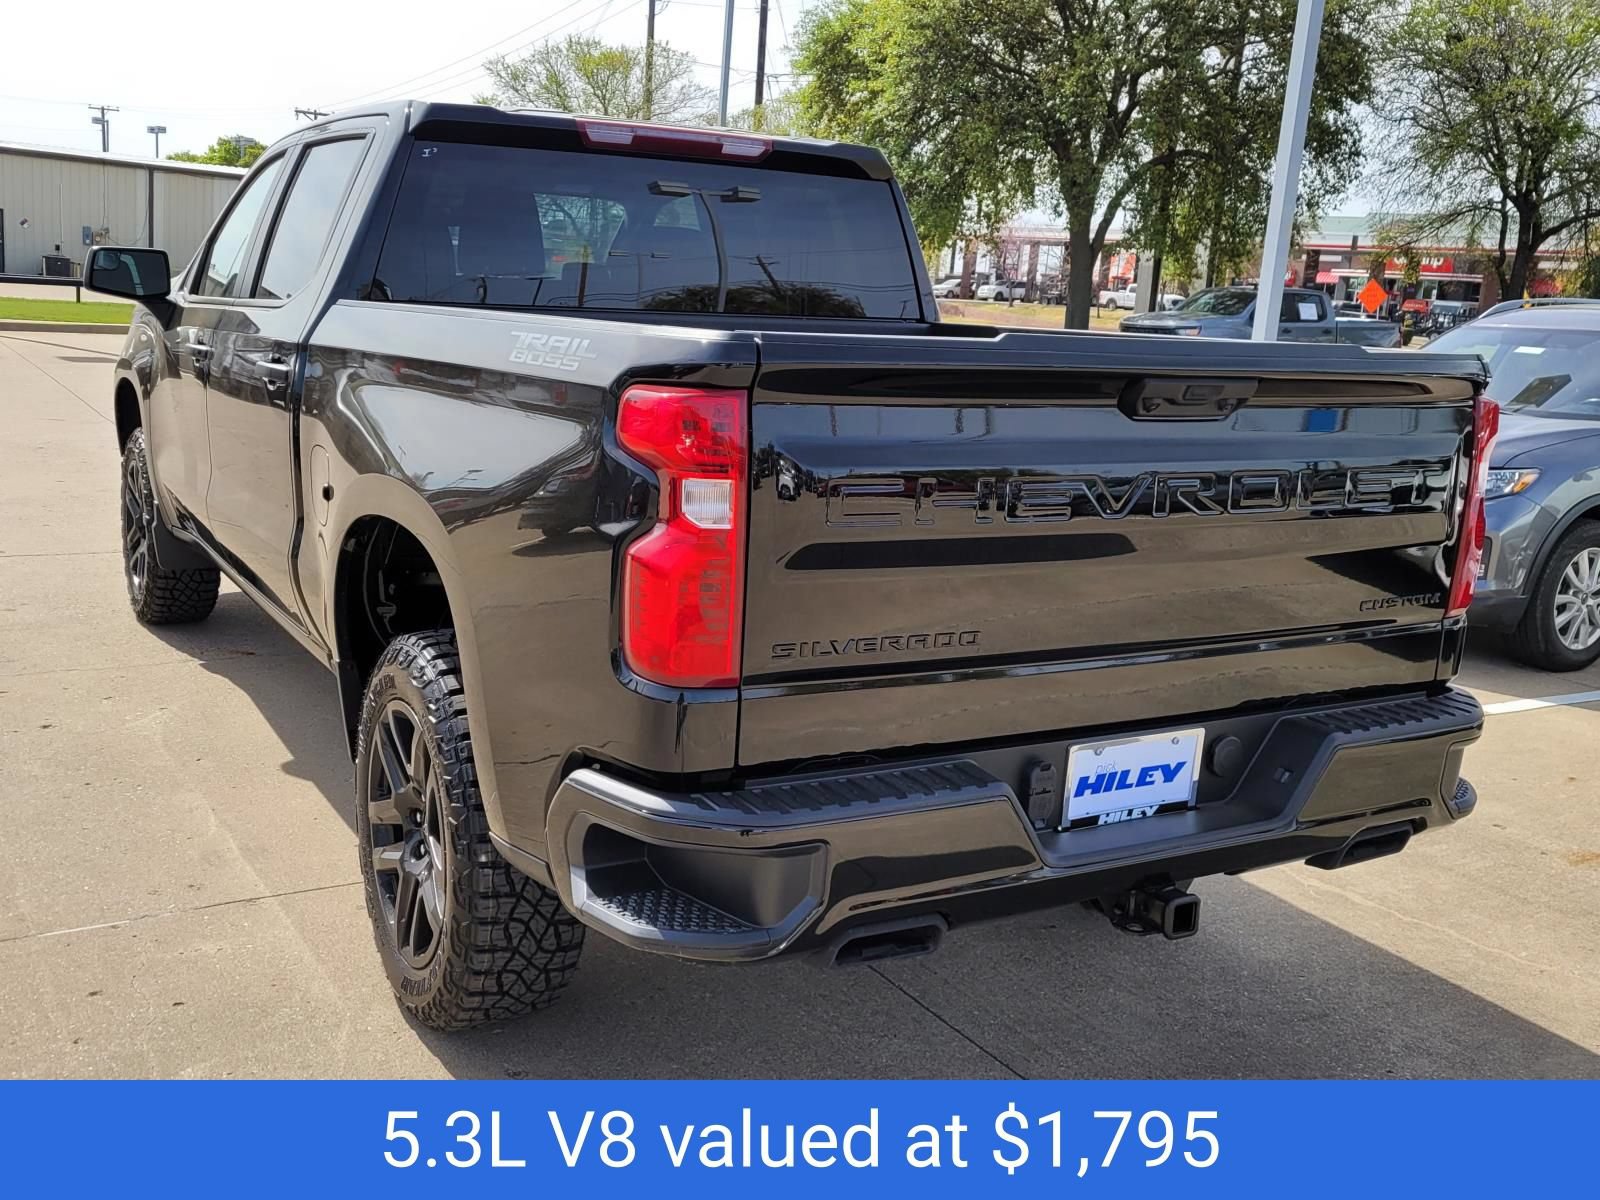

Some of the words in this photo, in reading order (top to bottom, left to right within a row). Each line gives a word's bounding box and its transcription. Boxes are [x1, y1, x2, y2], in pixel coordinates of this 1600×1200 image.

[510, 331, 597, 359] TRAIL
[509, 349, 581, 371] BOSS
[825, 463, 1444, 528] CHEVROLET
[1359, 592, 1441, 611] CUSTOM
[771, 630, 982, 660] SILVERADO
[1073, 760, 1188, 798] HILEY
[1097, 804, 1160, 825] HILEY
